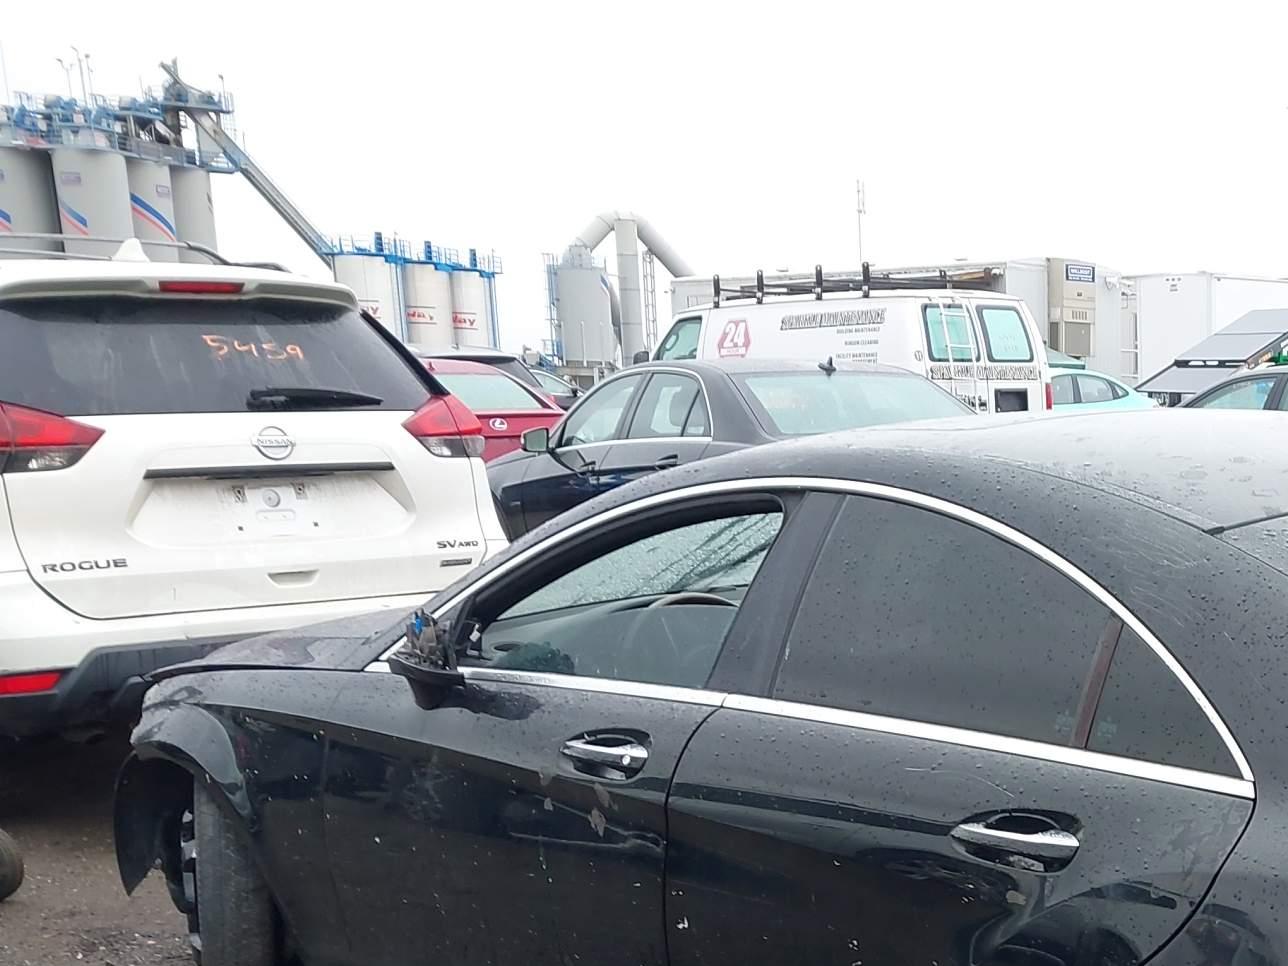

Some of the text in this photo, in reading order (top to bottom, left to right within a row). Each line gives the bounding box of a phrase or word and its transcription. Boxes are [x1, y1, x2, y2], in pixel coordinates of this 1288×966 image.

[723, 322, 746, 348] 24
[201, 335, 304, 361] 5459
[436, 539, 456, 549] SV
[41, 558, 128, 574] ROGUE
